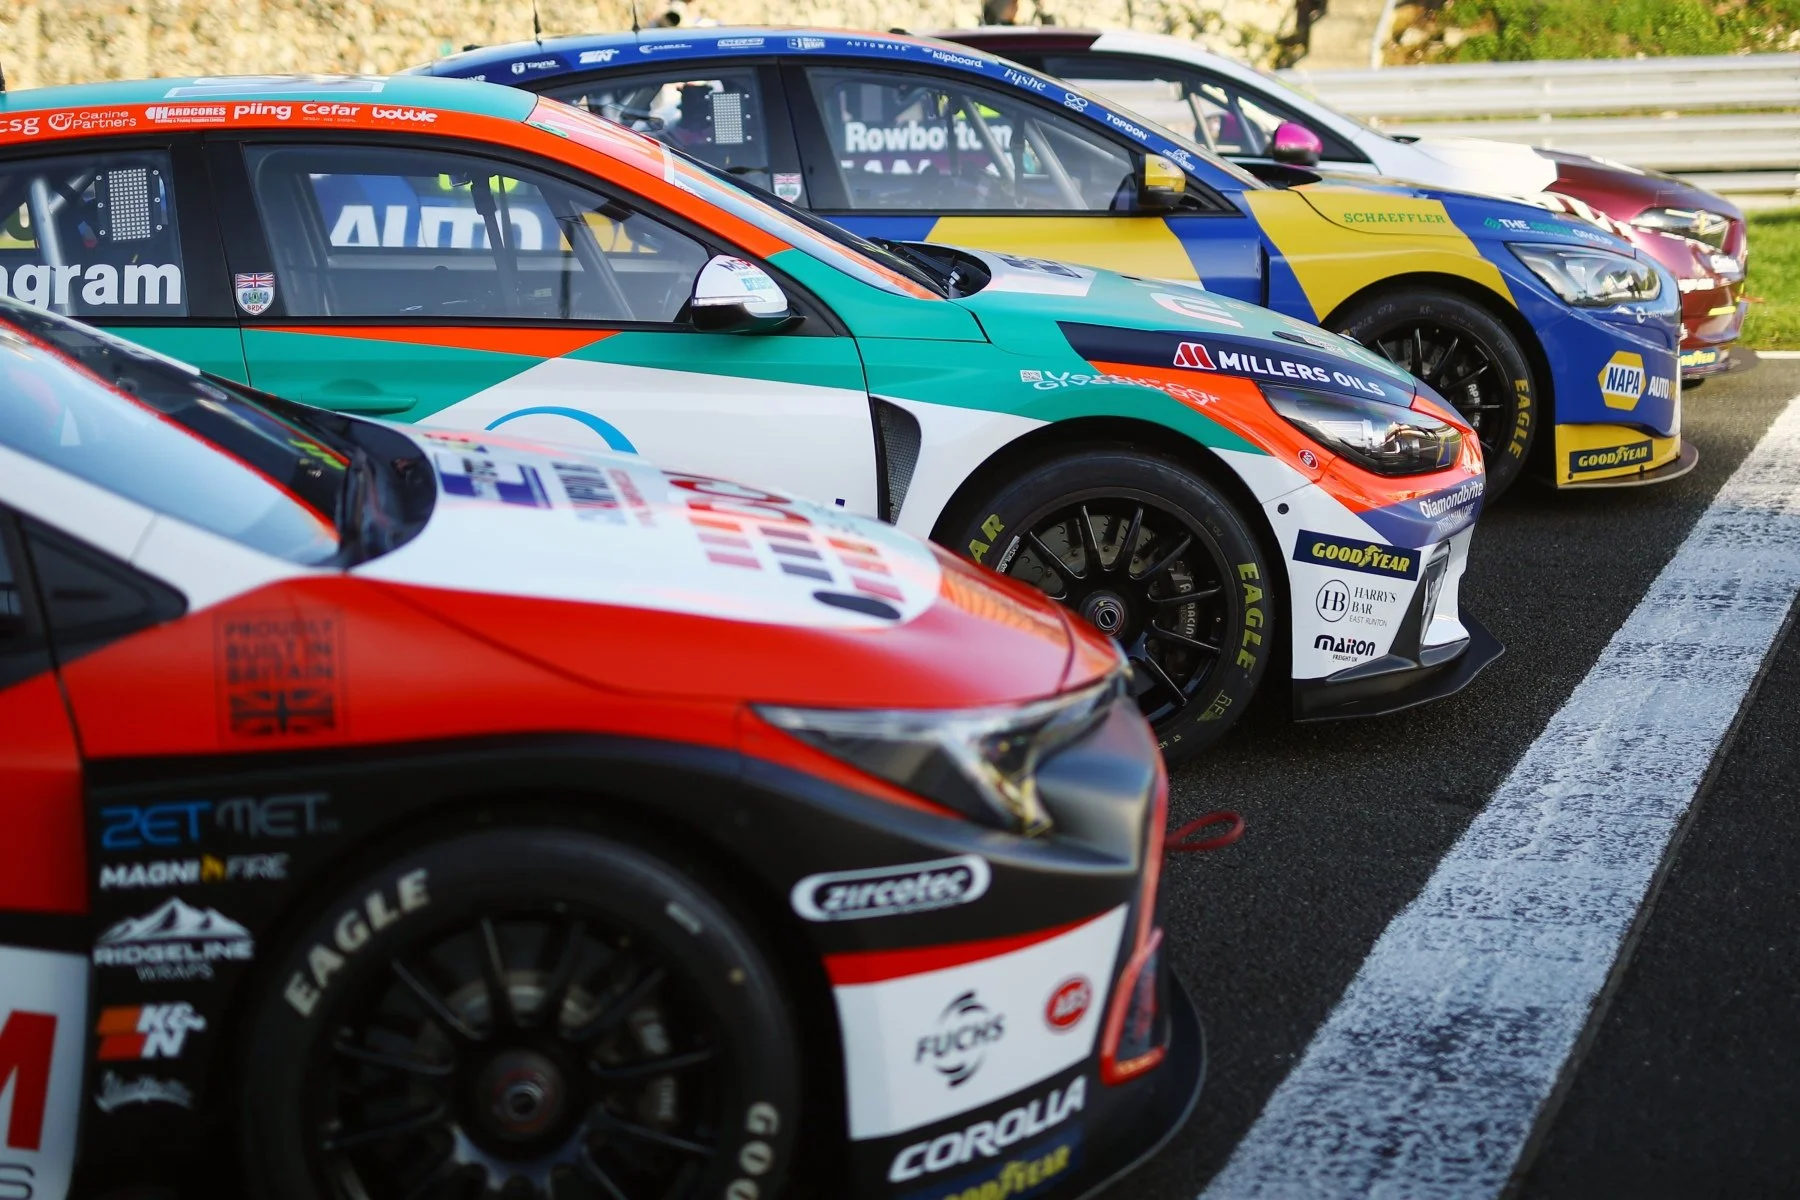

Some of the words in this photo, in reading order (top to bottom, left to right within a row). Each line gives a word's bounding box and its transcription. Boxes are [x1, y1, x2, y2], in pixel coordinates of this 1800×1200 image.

[846, 40, 907, 51] AUTOWAVE
[79, 110, 130, 120] Canine
[155, 106, 227, 120] HARDCORES
[301, 103, 361, 116] Cefar
[371, 106, 439, 123] bobble
[72, 117, 137, 129] Partners
[1105, 112, 1149, 141] TOPDON
[1343, 212, 1446, 225] SCHAEFFLER
[1498, 218, 1531, 230] THE
[1218, 350, 1331, 383] MILLERS
[1332, 371, 1387, 397] OILS
[1606, 366, 1641, 396] NAPA
[1648, 375, 1670, 398] AUTO
[1508, 379, 1531, 459] EAGLE
[1578, 446, 1649, 468] GOODYEAR
[1419, 481, 1484, 519] Diamondbrite
[1311, 542, 1411, 573] GOODYEAR
[1354, 587, 1397, 604] HARRY'S
[1237, 563, 1264, 673] EAGLE
[1349, 615, 1364, 623] EAST
[1351, 601, 1373, 615] BAR
[1332, 653, 1352, 661] FREIGHT
[821, 867, 970, 912] zircotec
[93, 939, 255, 966] RIDGELINE
[283, 867, 431, 1018] EAGLE
[914, 1013, 1006, 1063] FUCHS
[886, 1075, 1088, 1184] COROLLA
